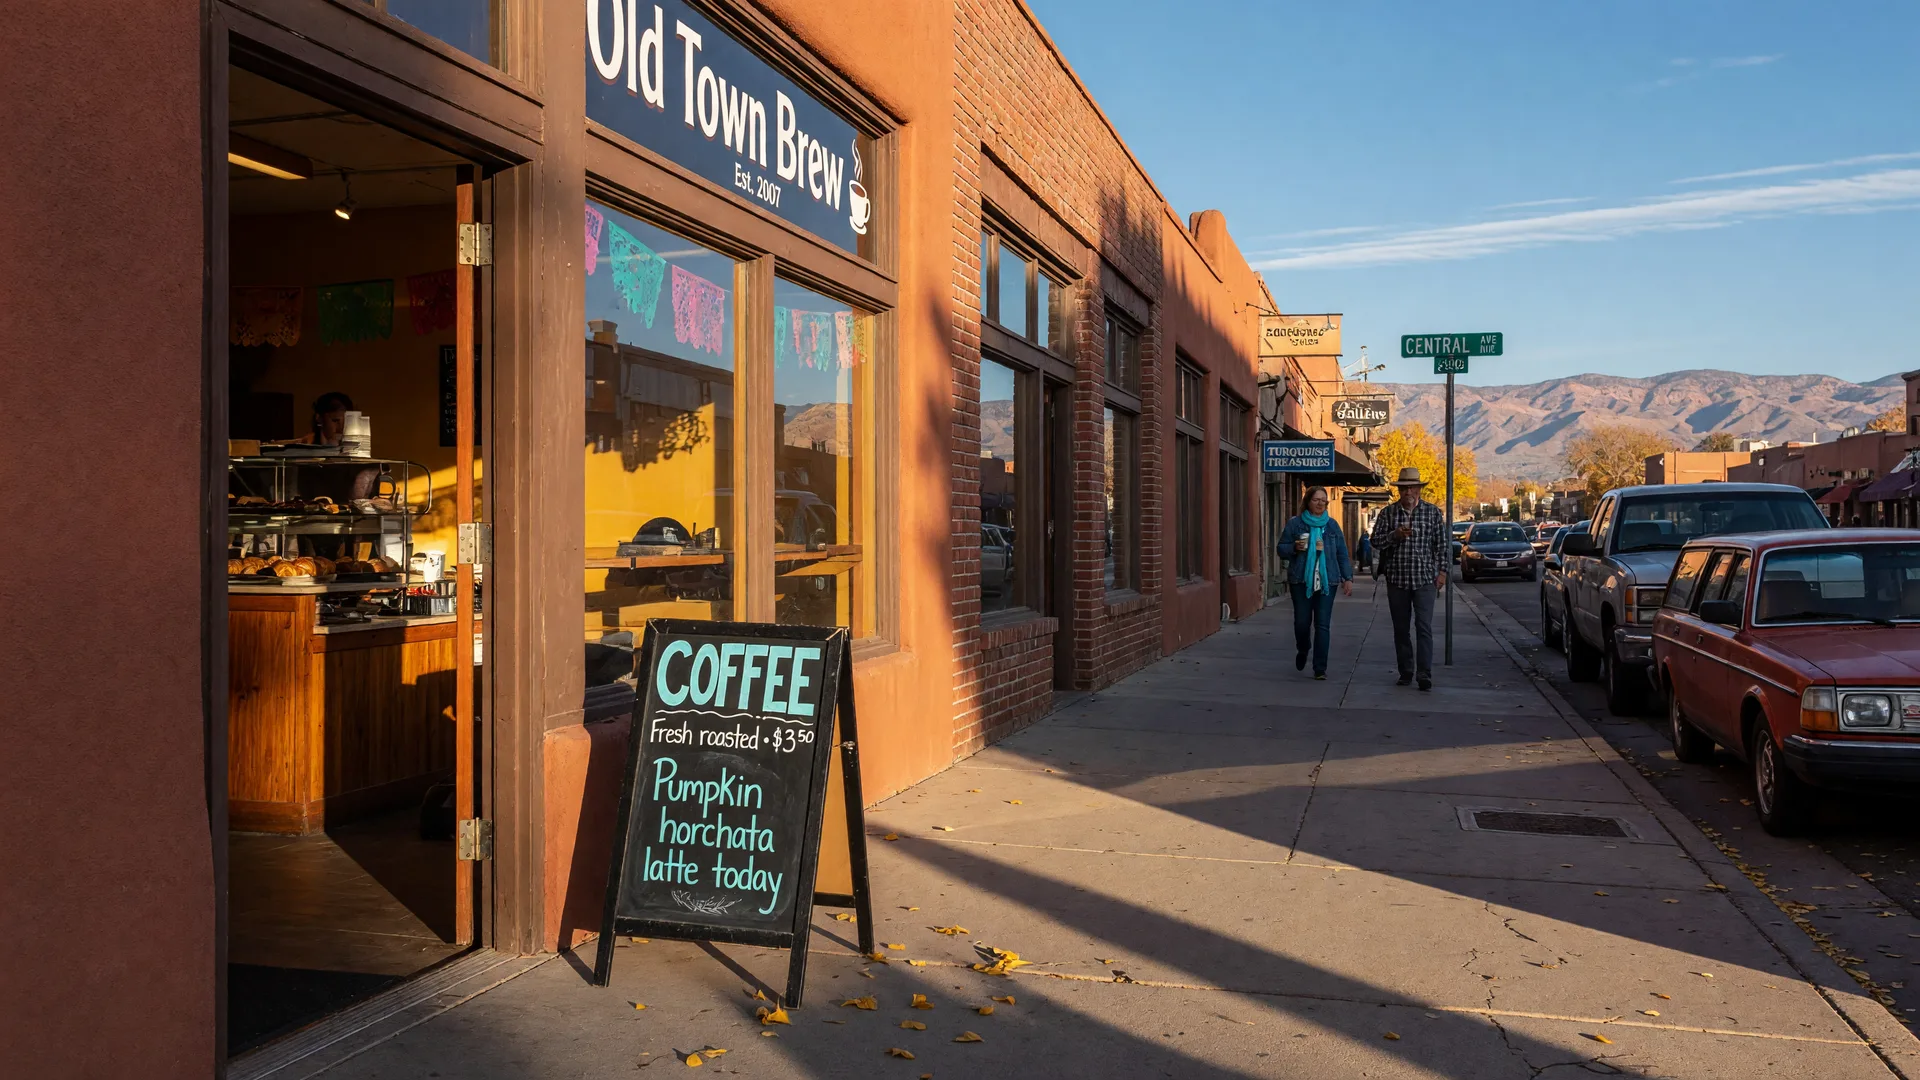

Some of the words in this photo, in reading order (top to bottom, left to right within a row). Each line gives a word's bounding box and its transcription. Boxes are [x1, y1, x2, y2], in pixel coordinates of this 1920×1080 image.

[587, 0, 664, 109] Old
[676, 19, 767, 168] Town
[776, 90, 844, 211] Brew
[756, 175, 782, 208] 2007
[1405, 336, 1471, 355] CENTRAL
[1480, 335, 1497, 345] AVE
[1267, 457, 1331, 467] TREASURES
[656, 639, 821, 717] COFFEE
[650, 717, 693, 745] Fresh
[699, 723, 760, 751] roasted
[653, 756, 763, 819] Pumpkin
[658, 805, 775, 853] horchata
[643, 846, 699, 885] latte
[711, 852, 783, 915] today
